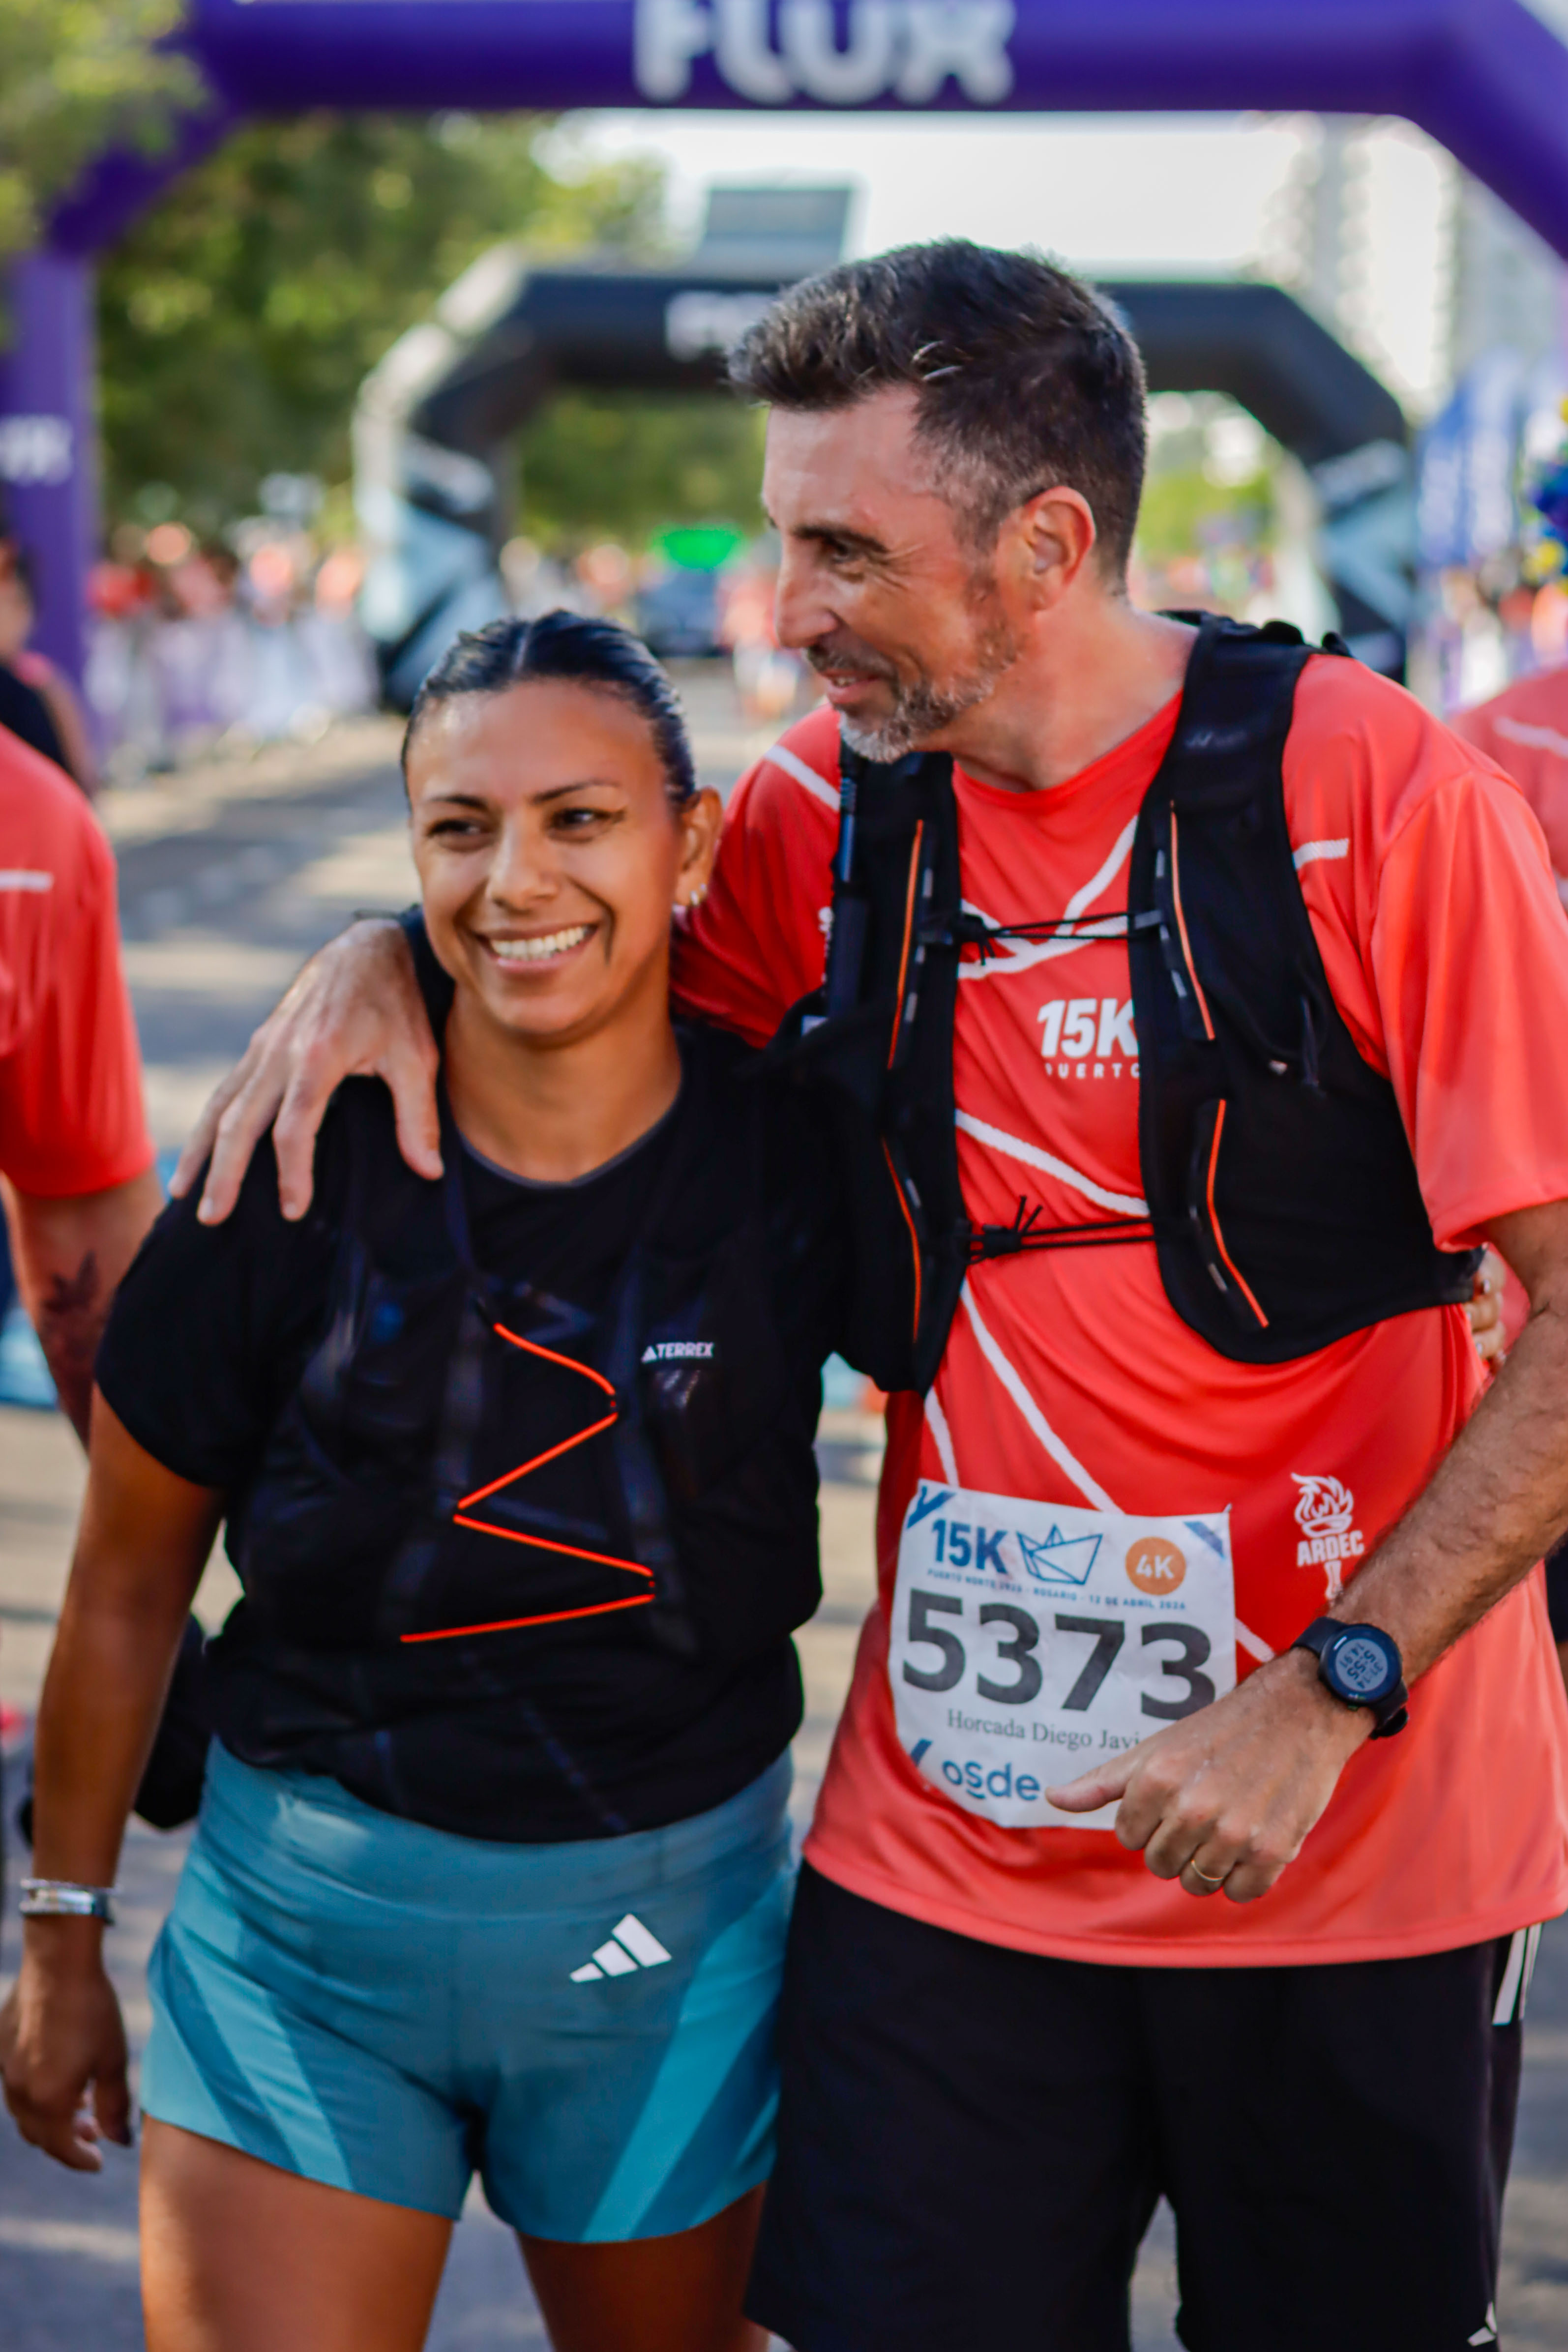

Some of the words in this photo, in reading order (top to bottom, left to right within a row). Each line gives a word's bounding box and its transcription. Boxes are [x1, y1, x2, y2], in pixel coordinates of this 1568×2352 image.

[1037, 998, 1139, 1058] 15K
[656, 1342, 714, 1358] TERREX
[931, 1518, 1008, 1575] 15K
[1297, 1530, 1365, 1567] ARDEC
[1136, 1554, 1175, 1579] 4K
[1033, 1587, 1077, 1602] ROSARIO
[1105, 1597, 1119, 1606] DE
[1123, 1598, 1154, 1609] ABRIL
[903, 1588, 1216, 1721] 5373
[1347, 1649, 1376, 1681] 5:55
[947, 1708, 1026, 1739] Horcada
[1032, 1722, 1093, 1751] Diego
[942, 1759, 1040, 1800] osde
